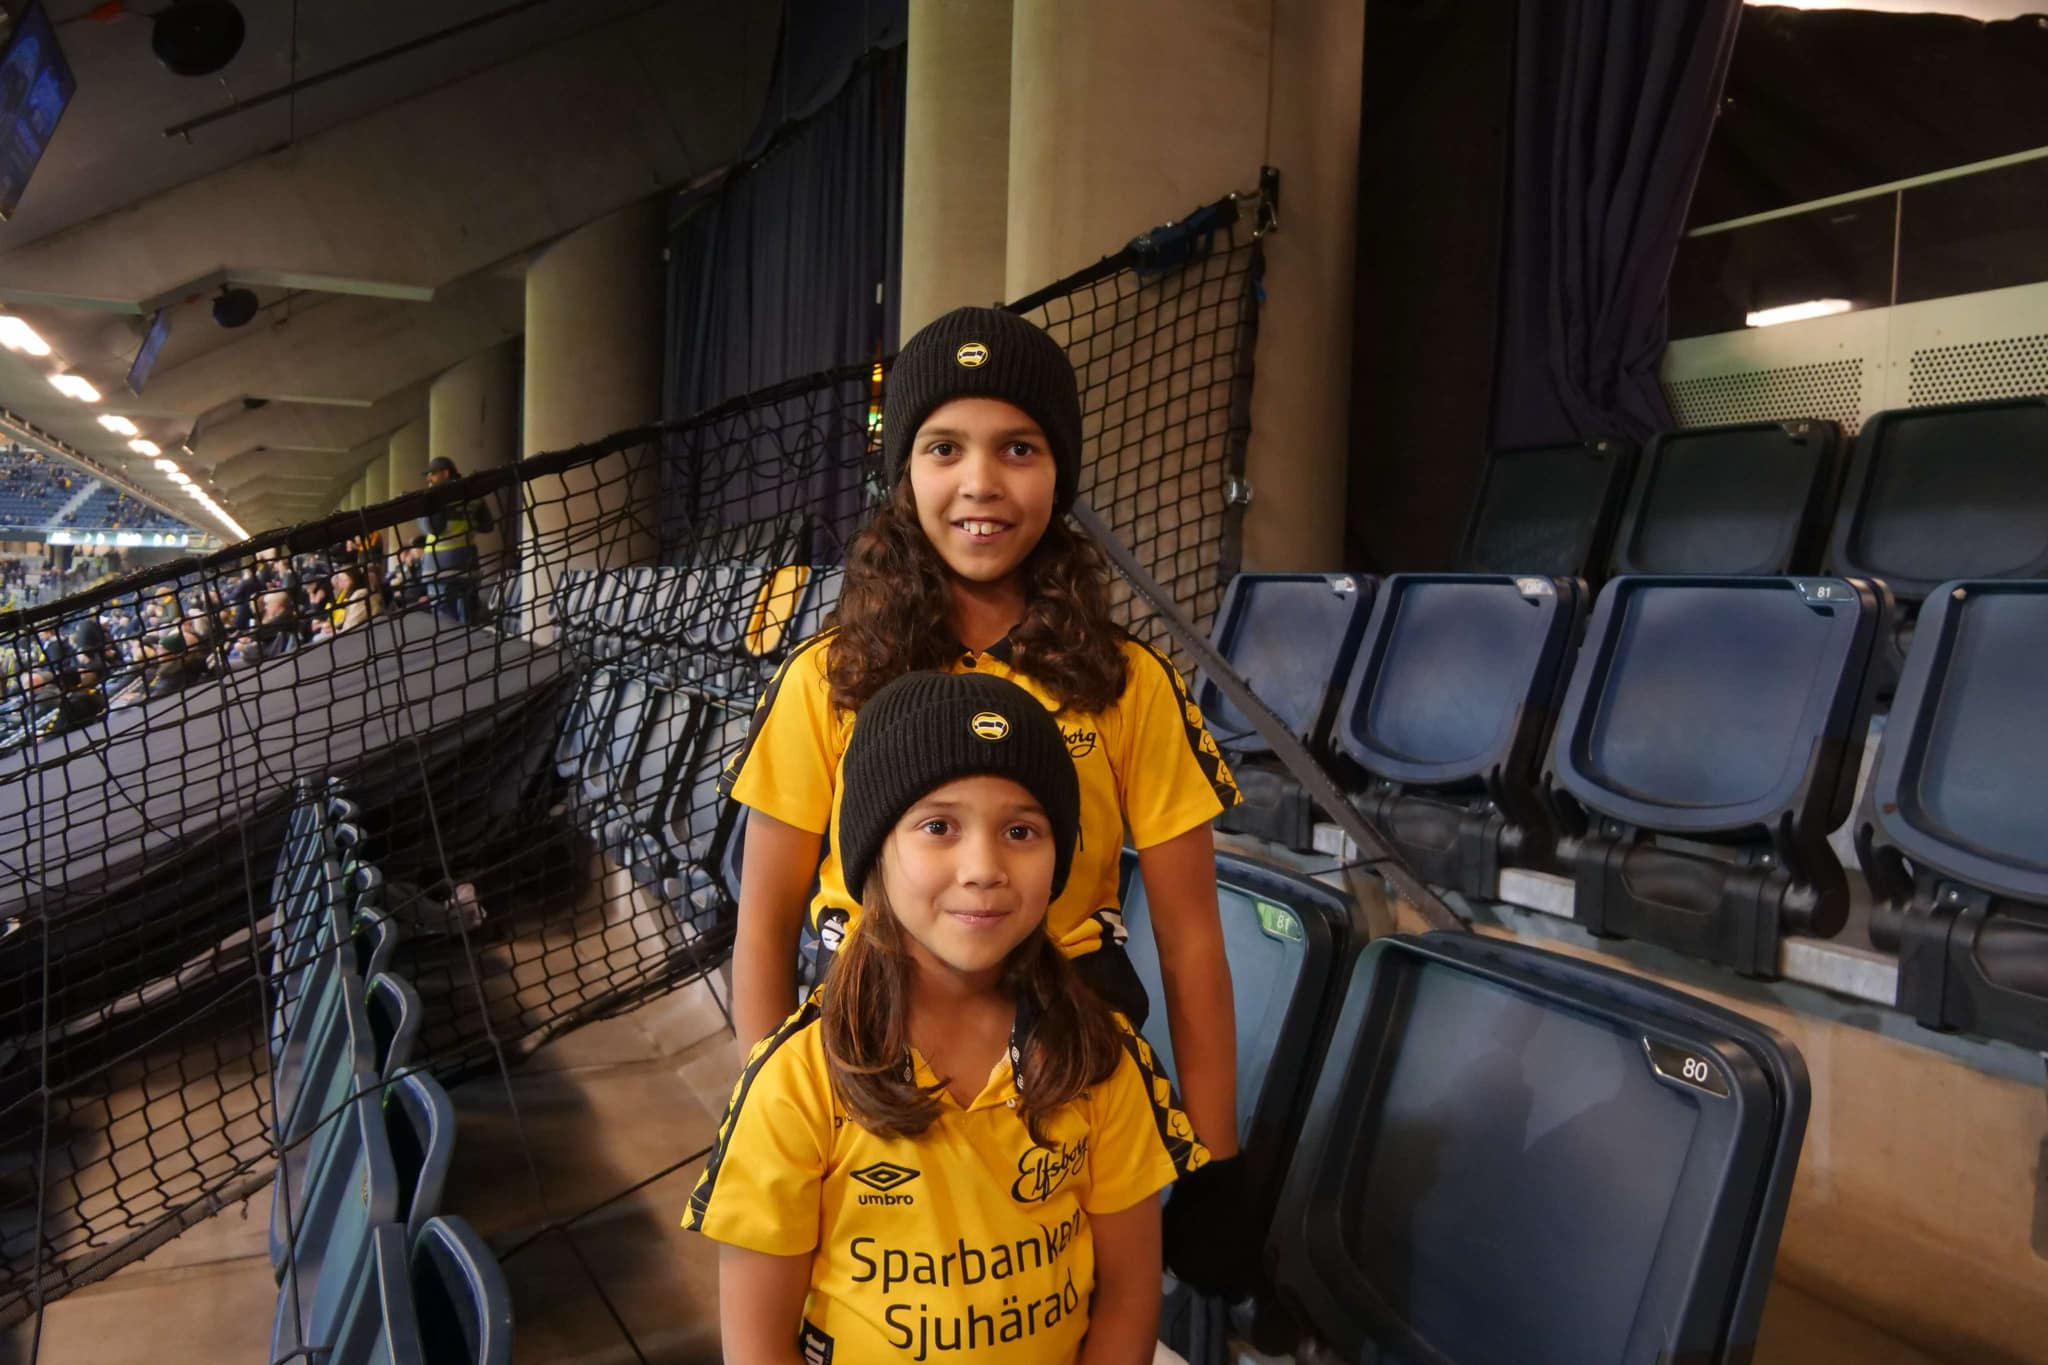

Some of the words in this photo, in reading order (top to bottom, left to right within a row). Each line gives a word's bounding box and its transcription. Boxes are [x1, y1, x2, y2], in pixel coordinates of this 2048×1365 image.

[1817, 587, 1831, 598] 81
[1061, 725, 1096, 758] borg
[1276, 915, 1291, 932] 81
[1682, 1058, 1708, 1082] 80
[1011, 1136, 1088, 1203] Elfsborg
[858, 1194, 914, 1206] umbro
[850, 1208, 1080, 1294] Sparbanken
[885, 1266, 1079, 1362] Sjuhärad
